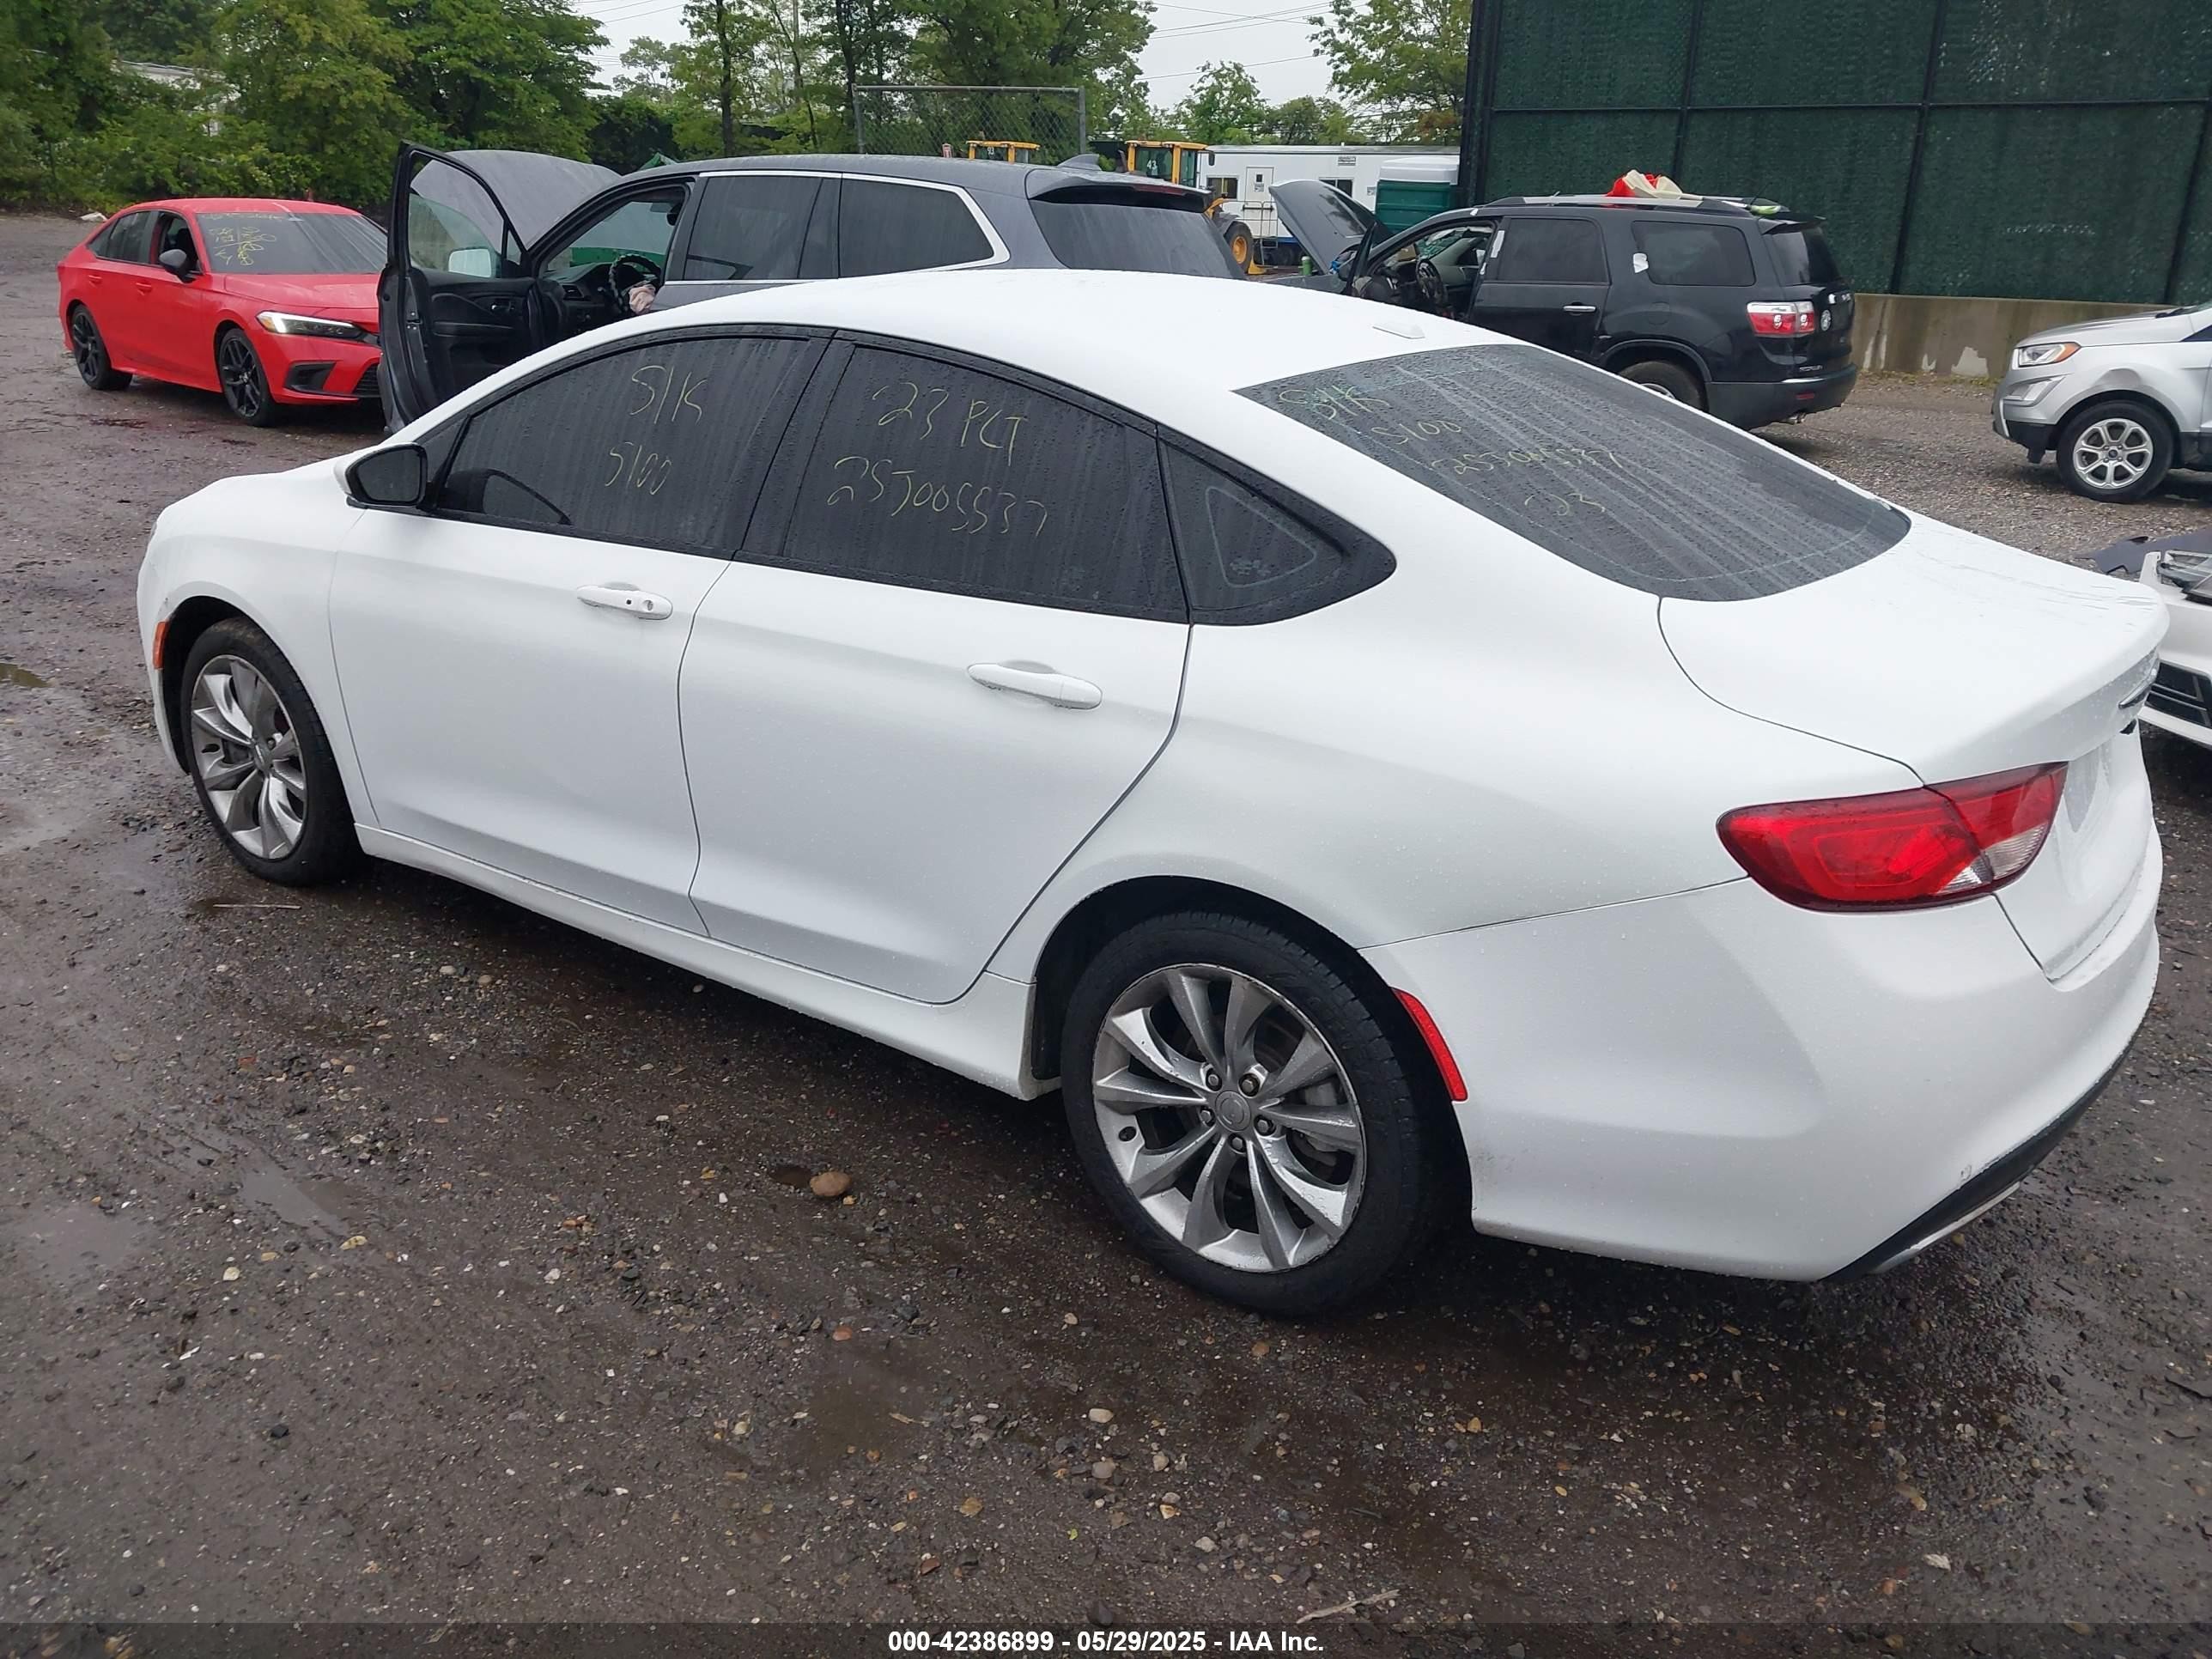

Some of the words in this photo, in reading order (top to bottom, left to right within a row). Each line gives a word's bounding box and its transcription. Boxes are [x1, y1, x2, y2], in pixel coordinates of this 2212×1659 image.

[1146, 159, 1158, 170] 43
[872, 381, 950, 440] 23
[960, 398, 1028, 467] PCT
